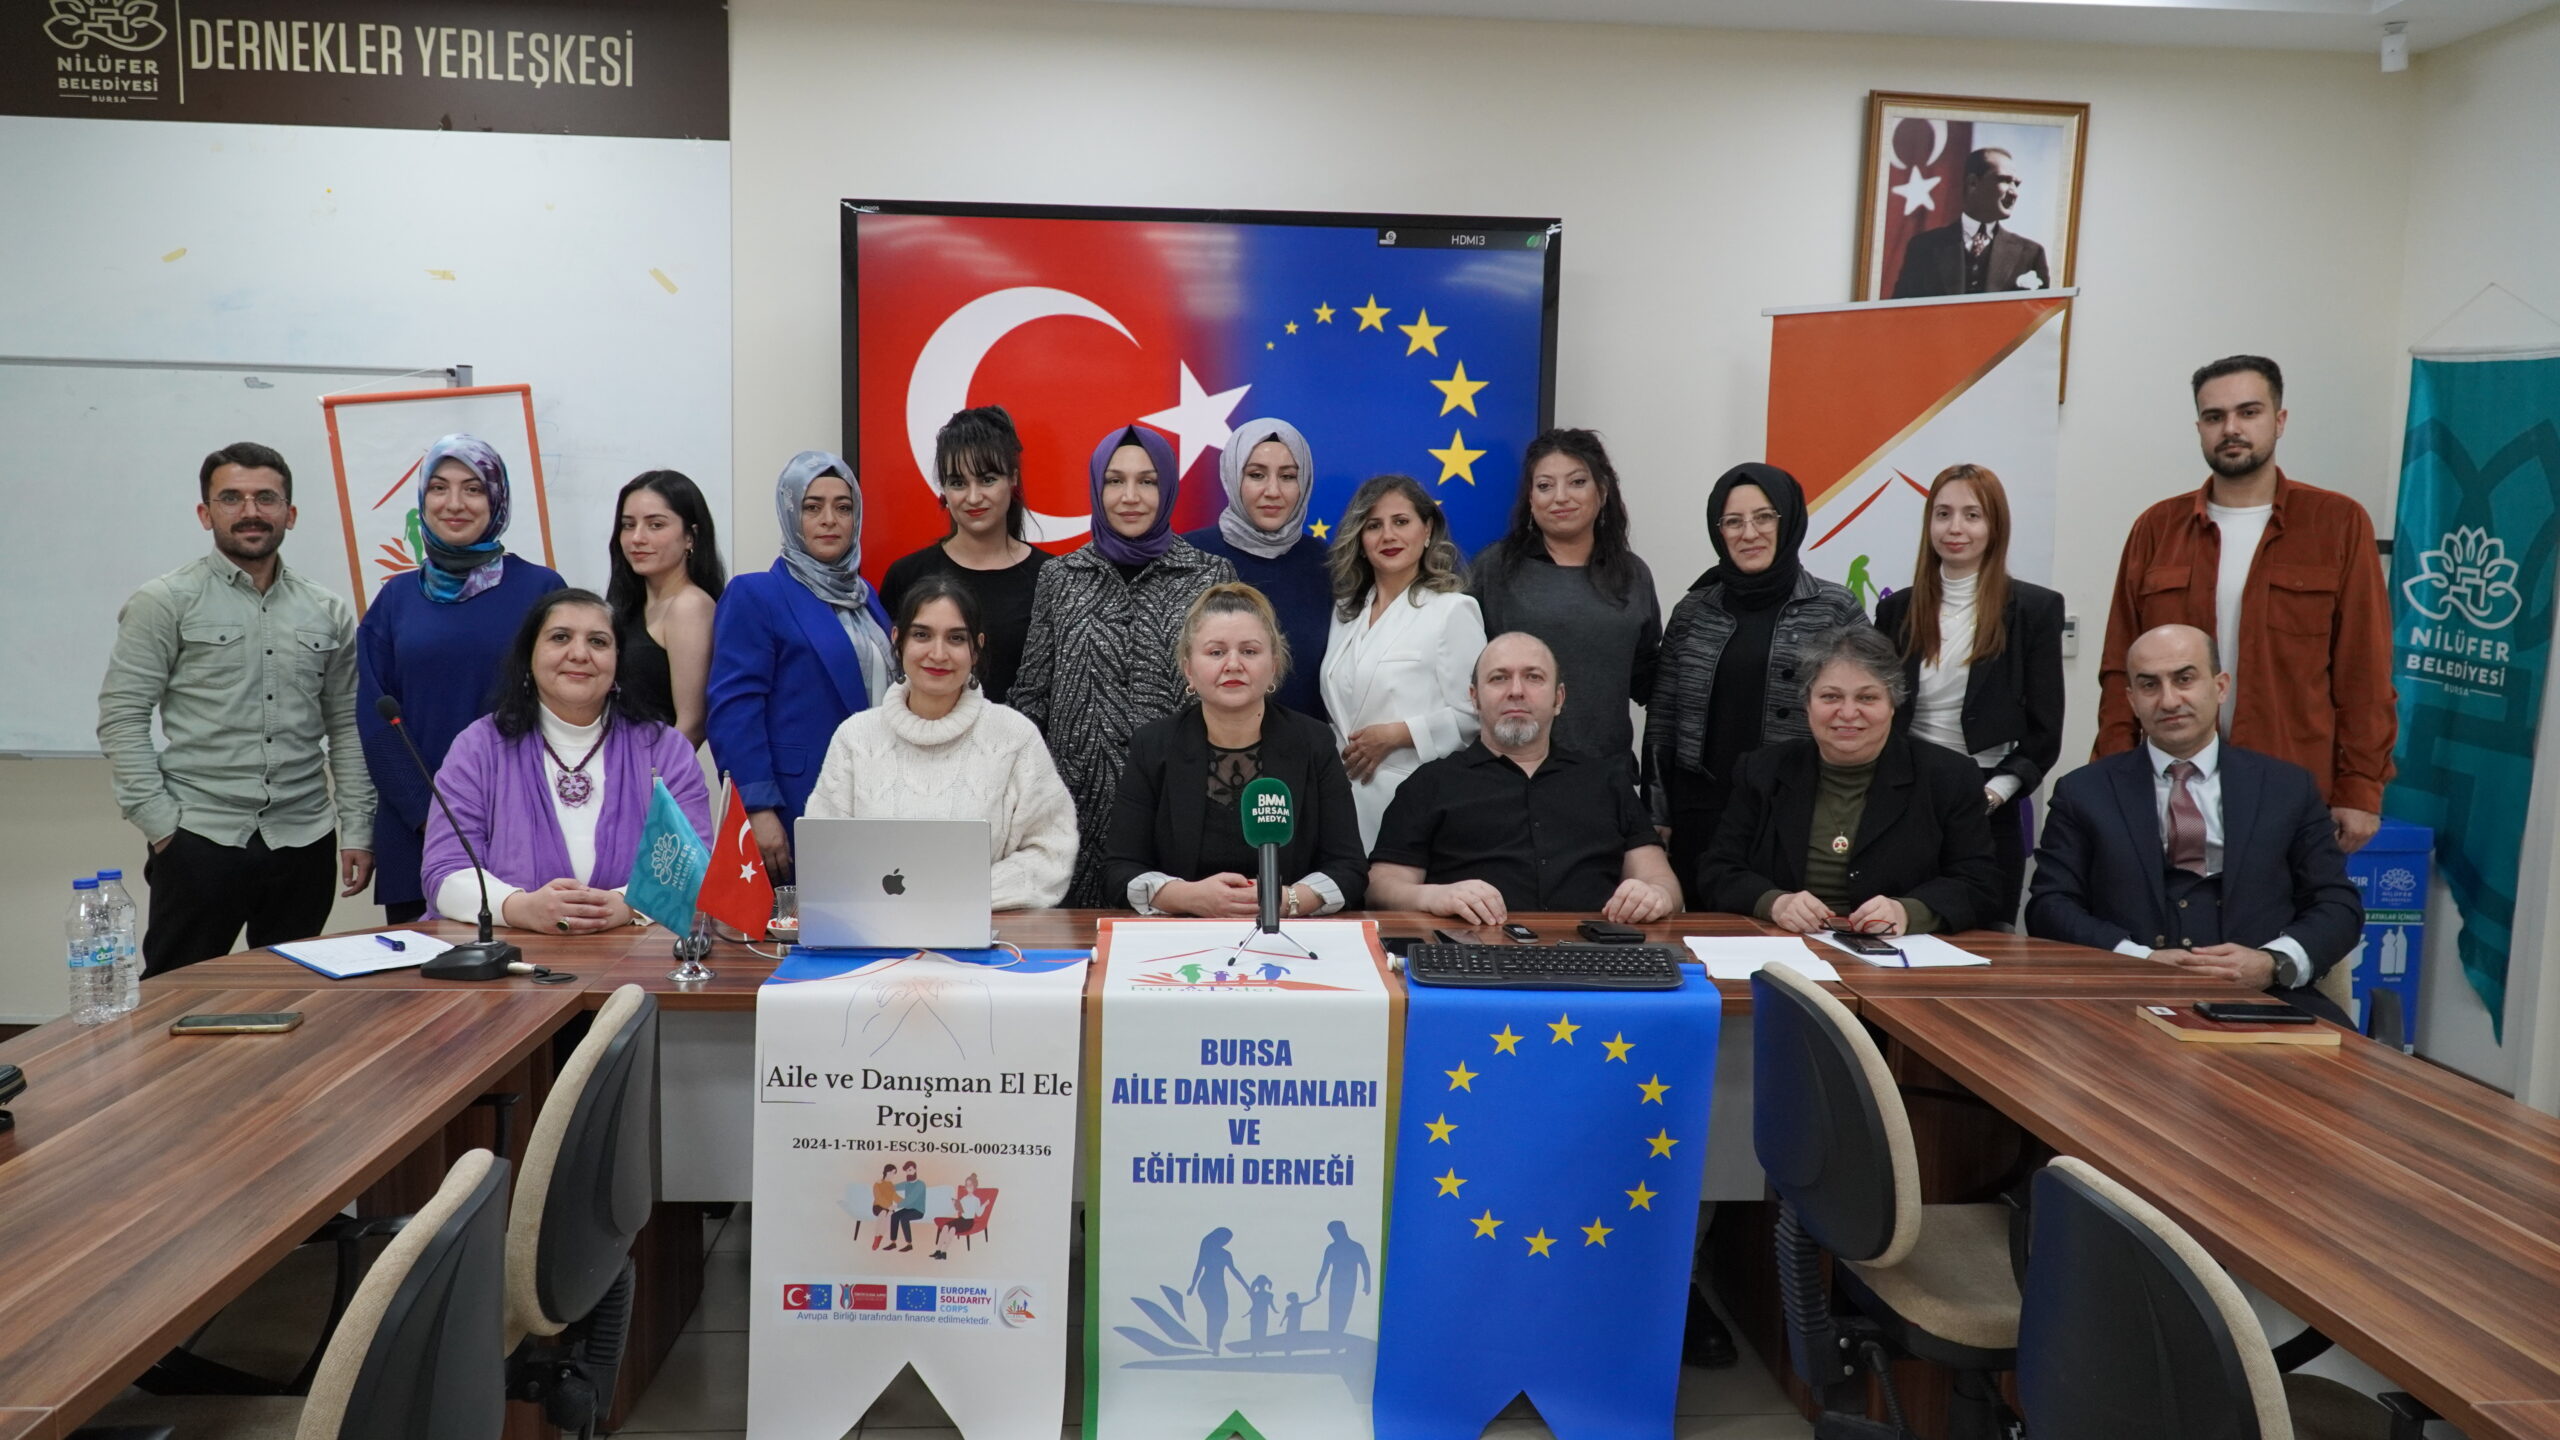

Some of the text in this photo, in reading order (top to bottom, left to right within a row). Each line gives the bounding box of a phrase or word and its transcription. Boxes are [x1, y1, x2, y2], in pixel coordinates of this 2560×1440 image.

[57, 53, 159, 75] NİLÜFER
[189, 18, 634, 90] DERNEKLER YERLEŞKESİ
[58, 76, 158, 92] BELEDİYESİ
[91, 95, 127, 103] BURSA
[1451, 235, 1486, 246] HDMI3
[2410, 625, 2510, 662] NİLÜFER
[2406, 653, 2506, 687] BELEDİYESİ
[2444, 683, 2470, 697] BURSA
[1252, 807, 1290, 816] BURSAM
[1257, 815, 1287, 823] MEDYA
[1200, 1038, 1293, 1067] BURSA
[766, 1065, 1073, 1097] Aile ve Danışman El Ele
[1112, 1073, 1377, 1112] AİLE DANIŞMANLARI
[876, 1105, 963, 1133] Projesi
[1228, 1118, 1261, 1145] VE
[792, 1137, 1052, 1157] 2024-1-TR01-ESC30-SOL-000234356
[1132, 1151, 1354, 1186] EĞİTİMİ DERNEĞİ
[940, 1286, 987, 1296] EUROPEAN
[940, 1295, 991, 1305] SOLIDARITY
[797, 1312, 828, 1322] Avrupa
[833, 1311, 857, 1322] Birliği
[859, 1313, 902, 1322] tarafından
[905, 1313, 935, 1323] finanse
[940, 1304, 969, 1313] CORPS
